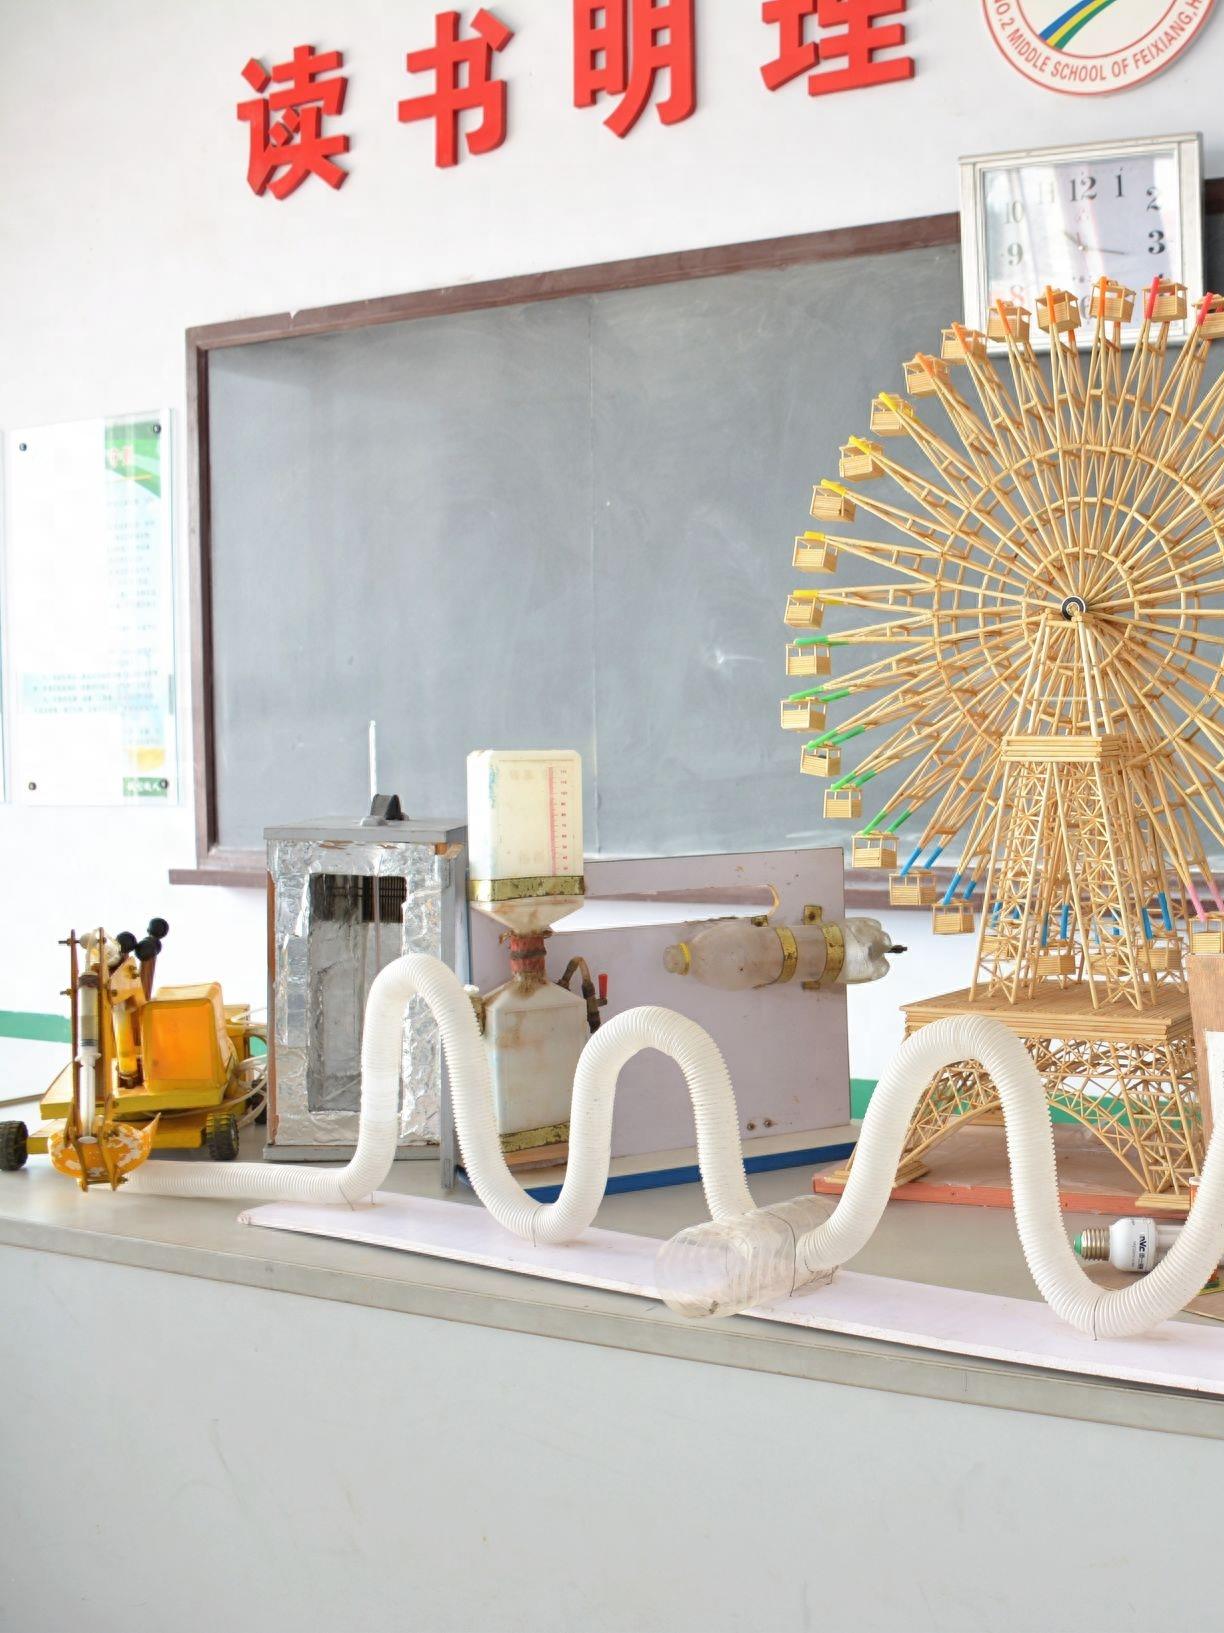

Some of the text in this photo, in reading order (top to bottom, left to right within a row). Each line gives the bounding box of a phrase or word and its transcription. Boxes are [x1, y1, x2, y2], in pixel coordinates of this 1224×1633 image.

[1007, 27, 1052, 73] MIDDLE
[1051, 60, 1107, 82] SCHOOL
[1111, 58, 1130, 78] OF
[1069, 176, 1098, 202] 12
[1115, 173, 1124, 198] 1
[1145, 186, 1161, 212] 2
[1003, 200, 1025, 225] 10
[1147, 229, 1166, 254] 3
[1007, 242, 1024, 267] 9
